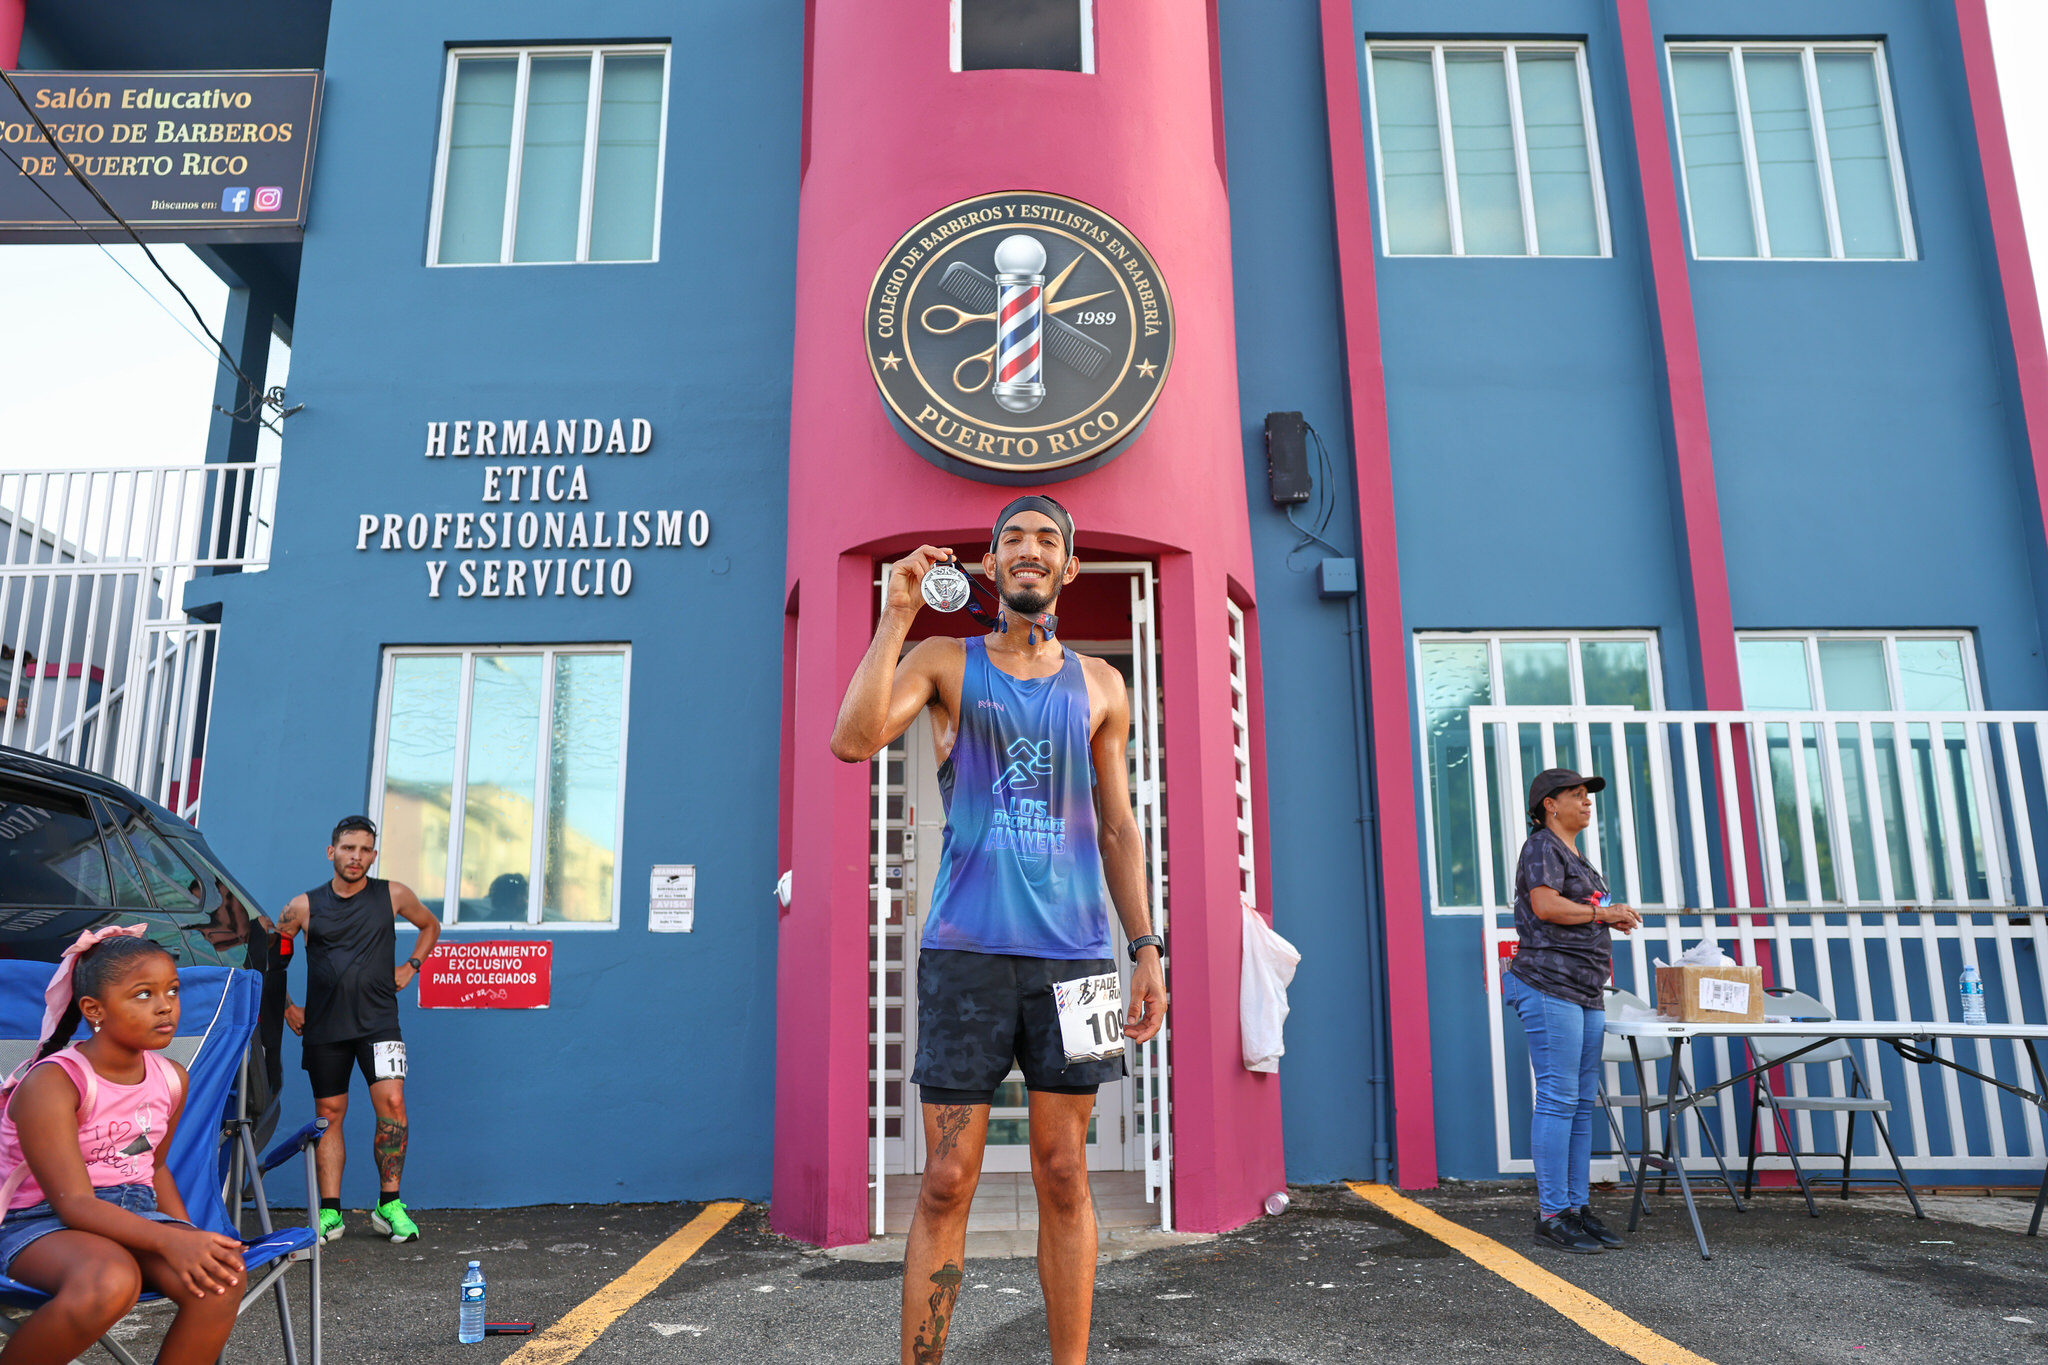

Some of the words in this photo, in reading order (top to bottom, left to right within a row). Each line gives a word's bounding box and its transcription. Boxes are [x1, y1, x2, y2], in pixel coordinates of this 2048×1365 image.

[35, 87, 111, 109] Salón
[121, 88, 252, 109] Educativo
[0, 120, 104, 144] OLEGIO
[111, 123, 147, 144] DE
[155, 120, 293, 144] BARBEROS
[19, 155, 57, 176] DE
[64, 153, 173, 176] PUERTO
[180, 153, 248, 176] RICO
[151, 199, 199, 211] Búscanos
[201, 201, 218, 211] en:
[878, 268, 908, 338] COLEGIO
[901, 246, 924, 270] DE
[921, 206, 1002, 251] BARBEROS
[1004, 204, 1017, 218] Y
[1020, 204, 1109, 244] ESTILISTAS
[1105, 240, 1128, 261] EN
[1123, 258, 1163, 337] BARBERÍA
[1075, 311, 1117, 326] 1989
[425, 418, 653, 457] HERMANDAD
[915, 404, 1039, 457] PUERTO
[1047, 410, 1120, 454] RICO
[482, 464, 589, 502] ETICA
[356, 509, 711, 551] PROFESIONALISMO
[426, 560, 448, 598] Y
[457, 558, 633, 597] SERVICIO
[1009, 796, 1047, 818] LOS
[656, 900, 687, 908] AVISO
[449, 958, 522, 970] EXCLUSIVO
[433, 973, 461, 984] PARA
[466, 972, 536, 984] COLEGIADOS
[1094, 976, 1117, 991] FADE
[461, 992, 475, 1003] LEY
